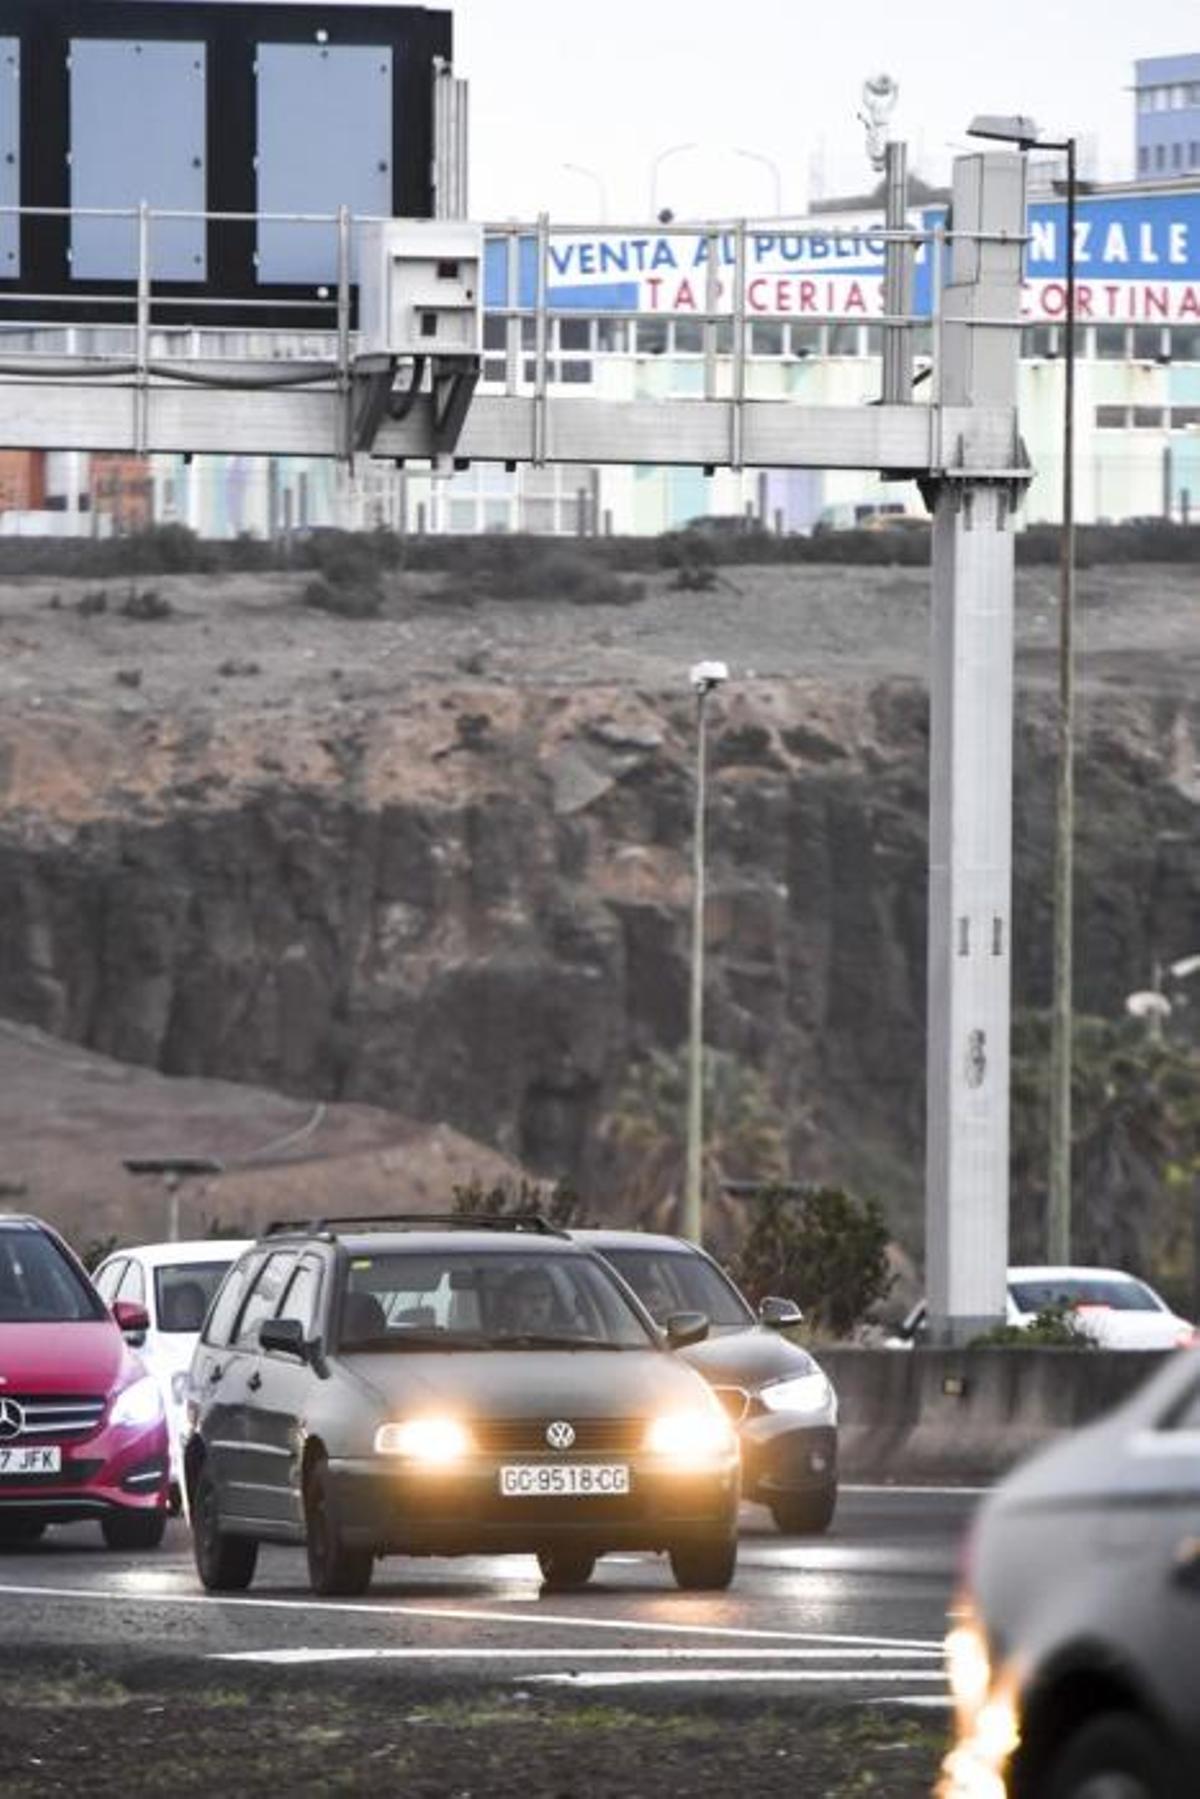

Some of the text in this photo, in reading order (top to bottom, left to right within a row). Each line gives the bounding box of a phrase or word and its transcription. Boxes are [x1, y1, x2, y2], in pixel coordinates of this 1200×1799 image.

[549, 224, 917, 275] VENTA AL PUBLIC
[645, 277, 887, 313] TACERIA
[19, 1450, 53, 1469] JFK
